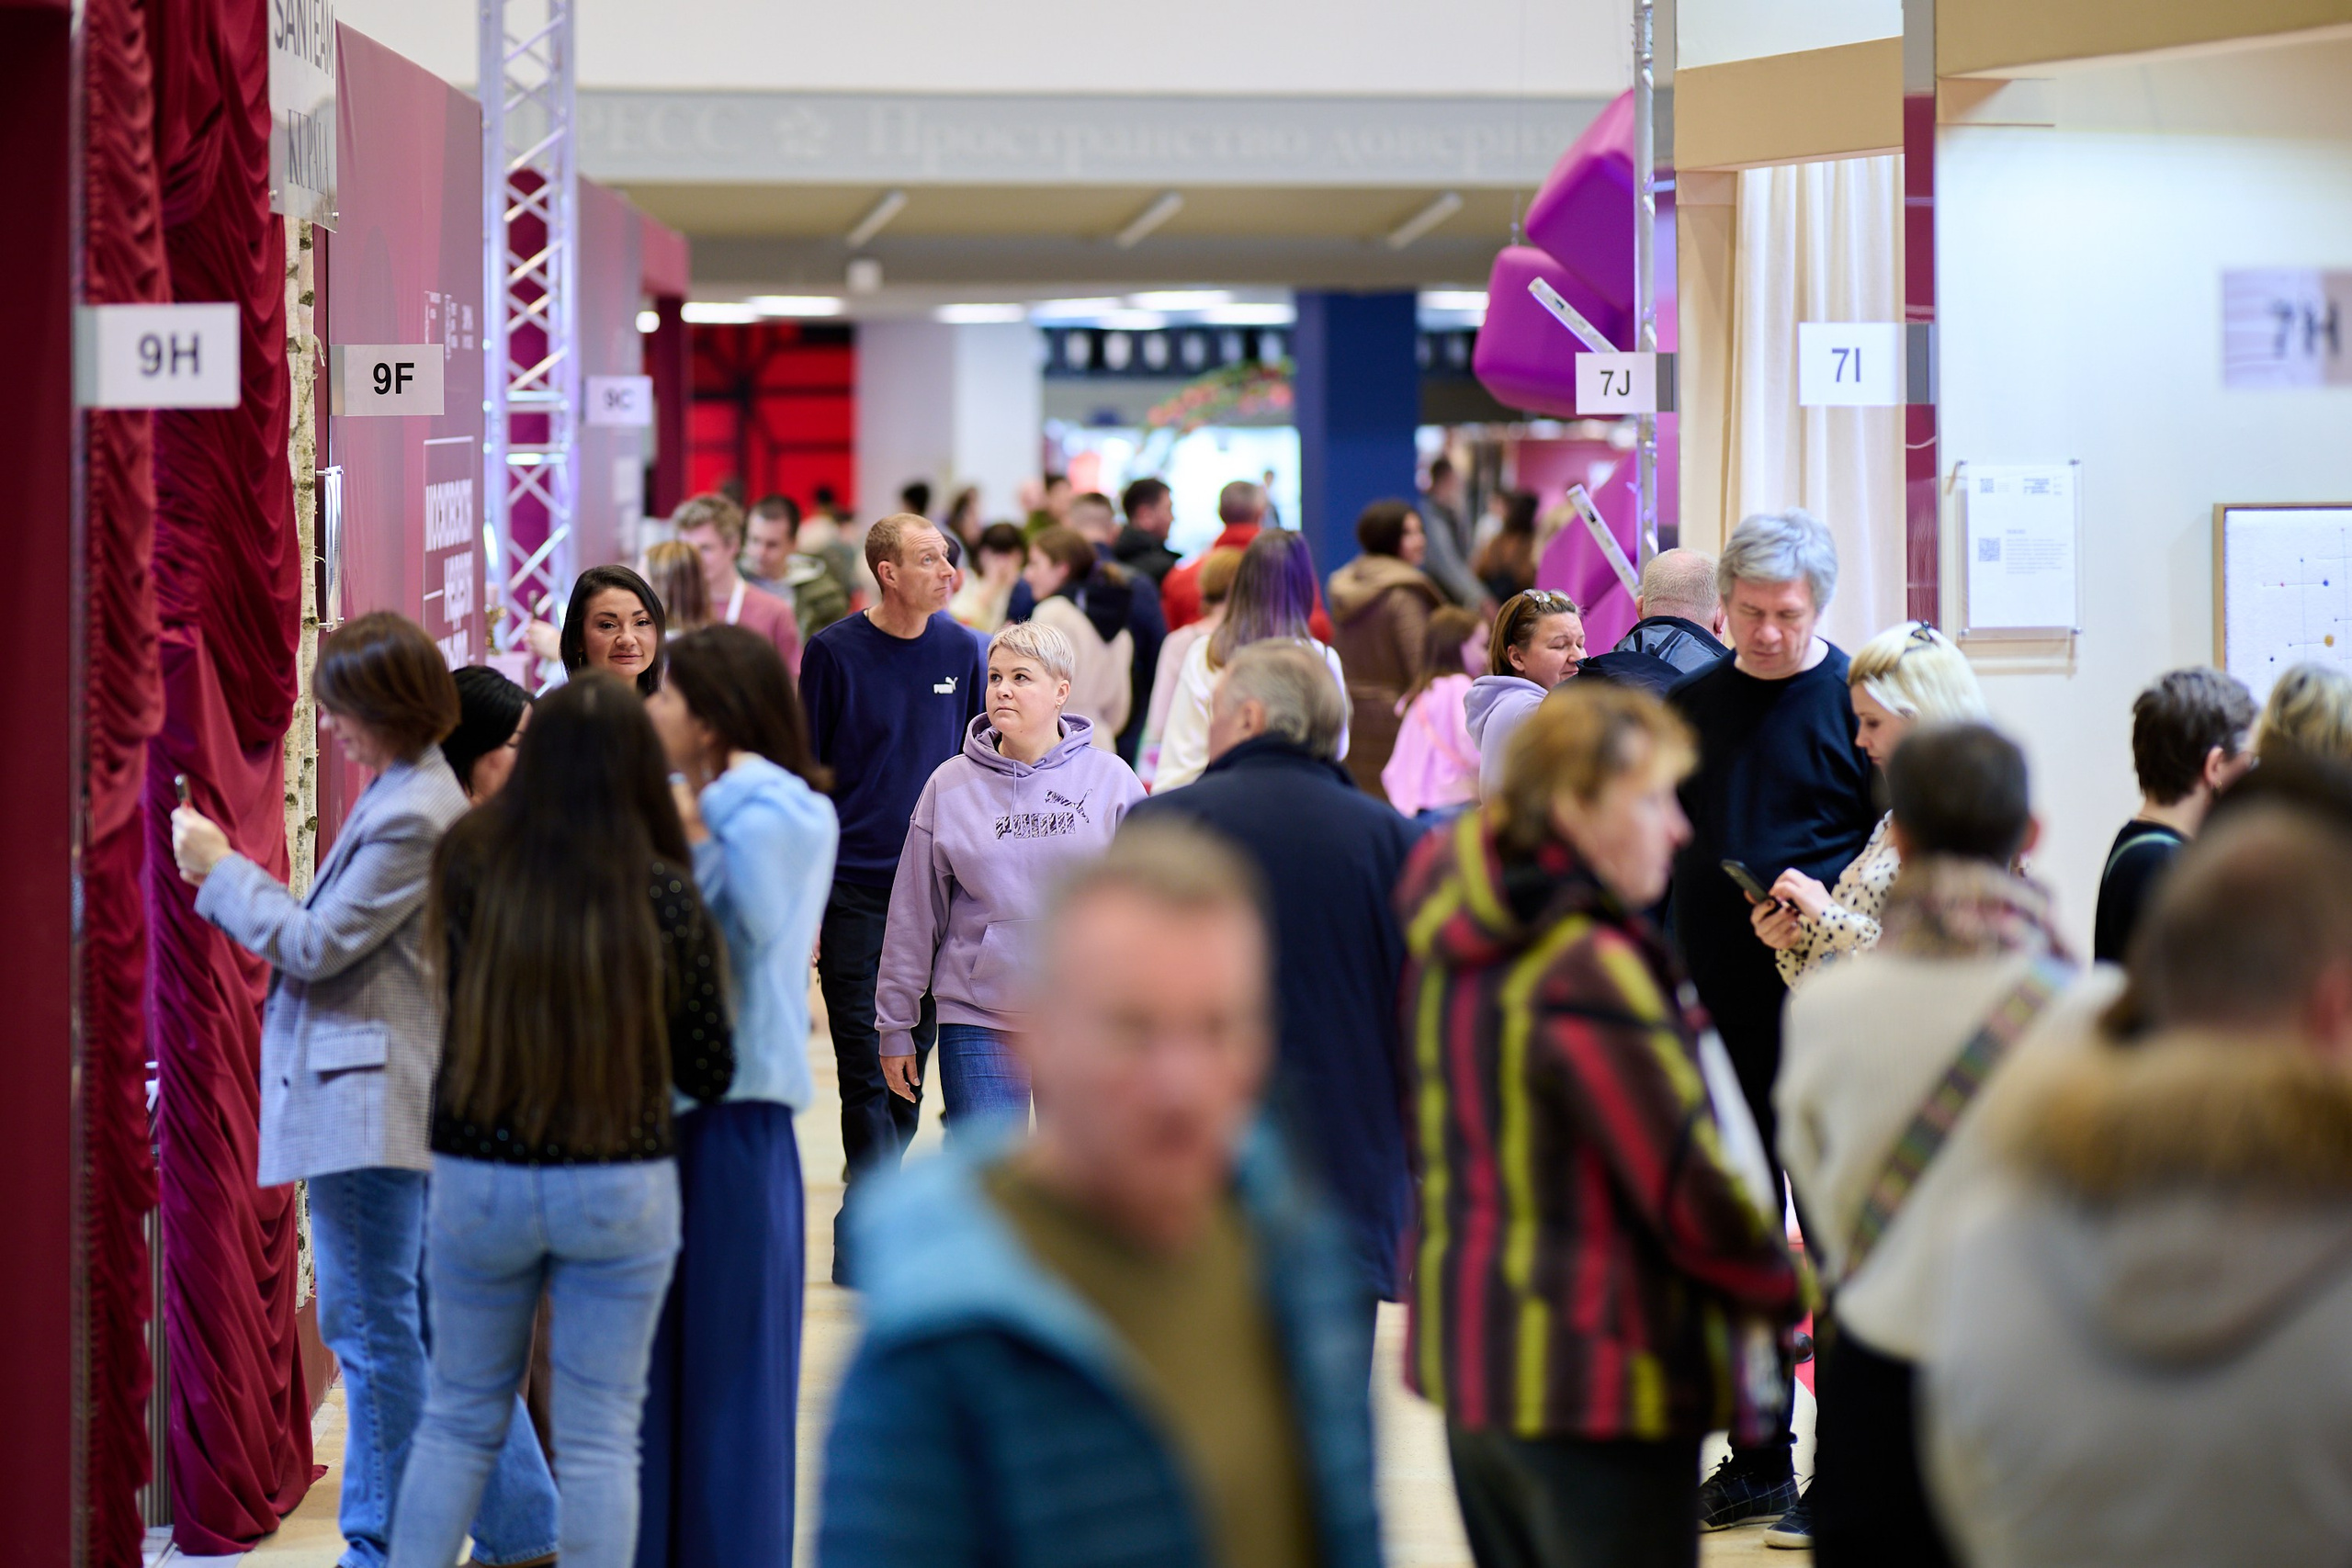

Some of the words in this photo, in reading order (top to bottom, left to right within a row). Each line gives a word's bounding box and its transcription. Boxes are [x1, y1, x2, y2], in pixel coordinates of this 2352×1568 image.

[2266, 299, 2341, 360] 7H
[139, 332, 201, 378] 9H
[1831, 347, 1861, 383] 7I
[373, 362, 414, 395] 9F
[1600, 369, 1630, 397] 7J
[995, 812, 1076, 840] PUMA
